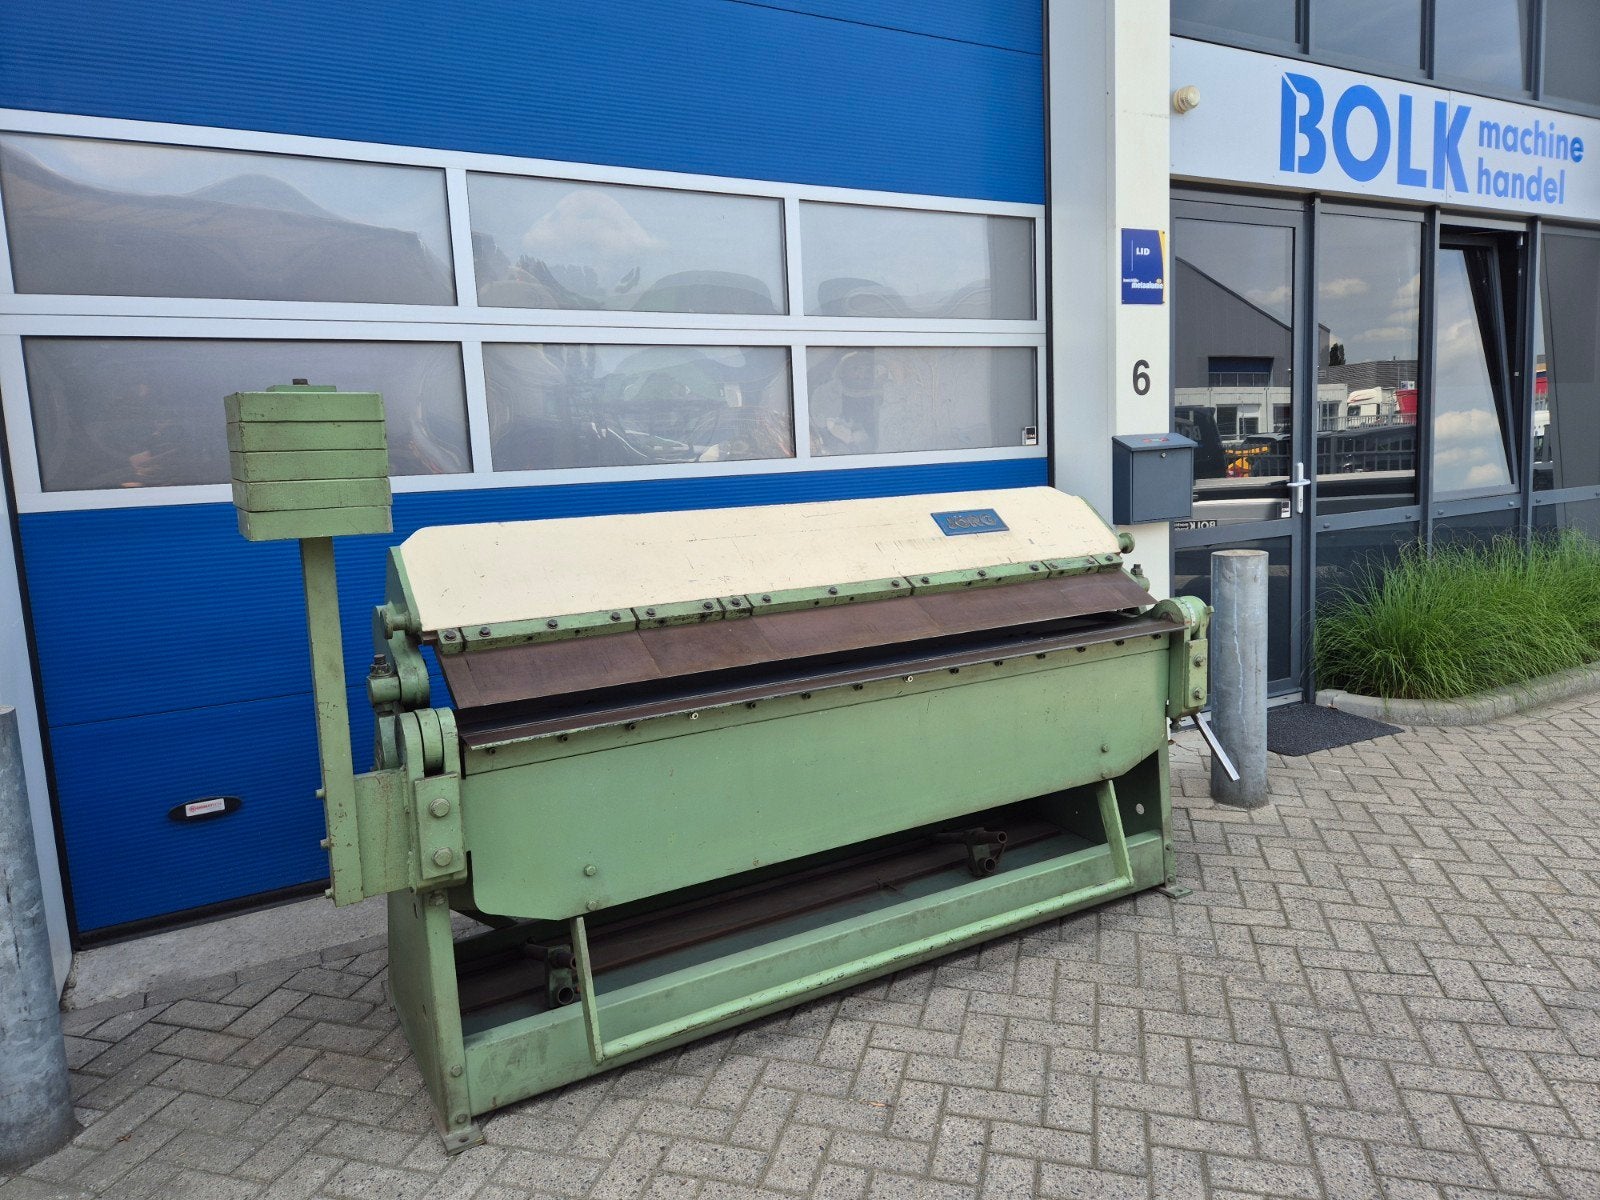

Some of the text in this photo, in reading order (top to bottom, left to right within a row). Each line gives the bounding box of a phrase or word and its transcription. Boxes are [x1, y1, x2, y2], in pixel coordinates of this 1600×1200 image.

[1279, 71, 1472, 193] BOLK
[1478, 119, 1584, 163] machine
[1476, 157, 1566, 205] handel
[1136, 247, 1150, 256] LID
[1132, 359, 1150, 396] 6
